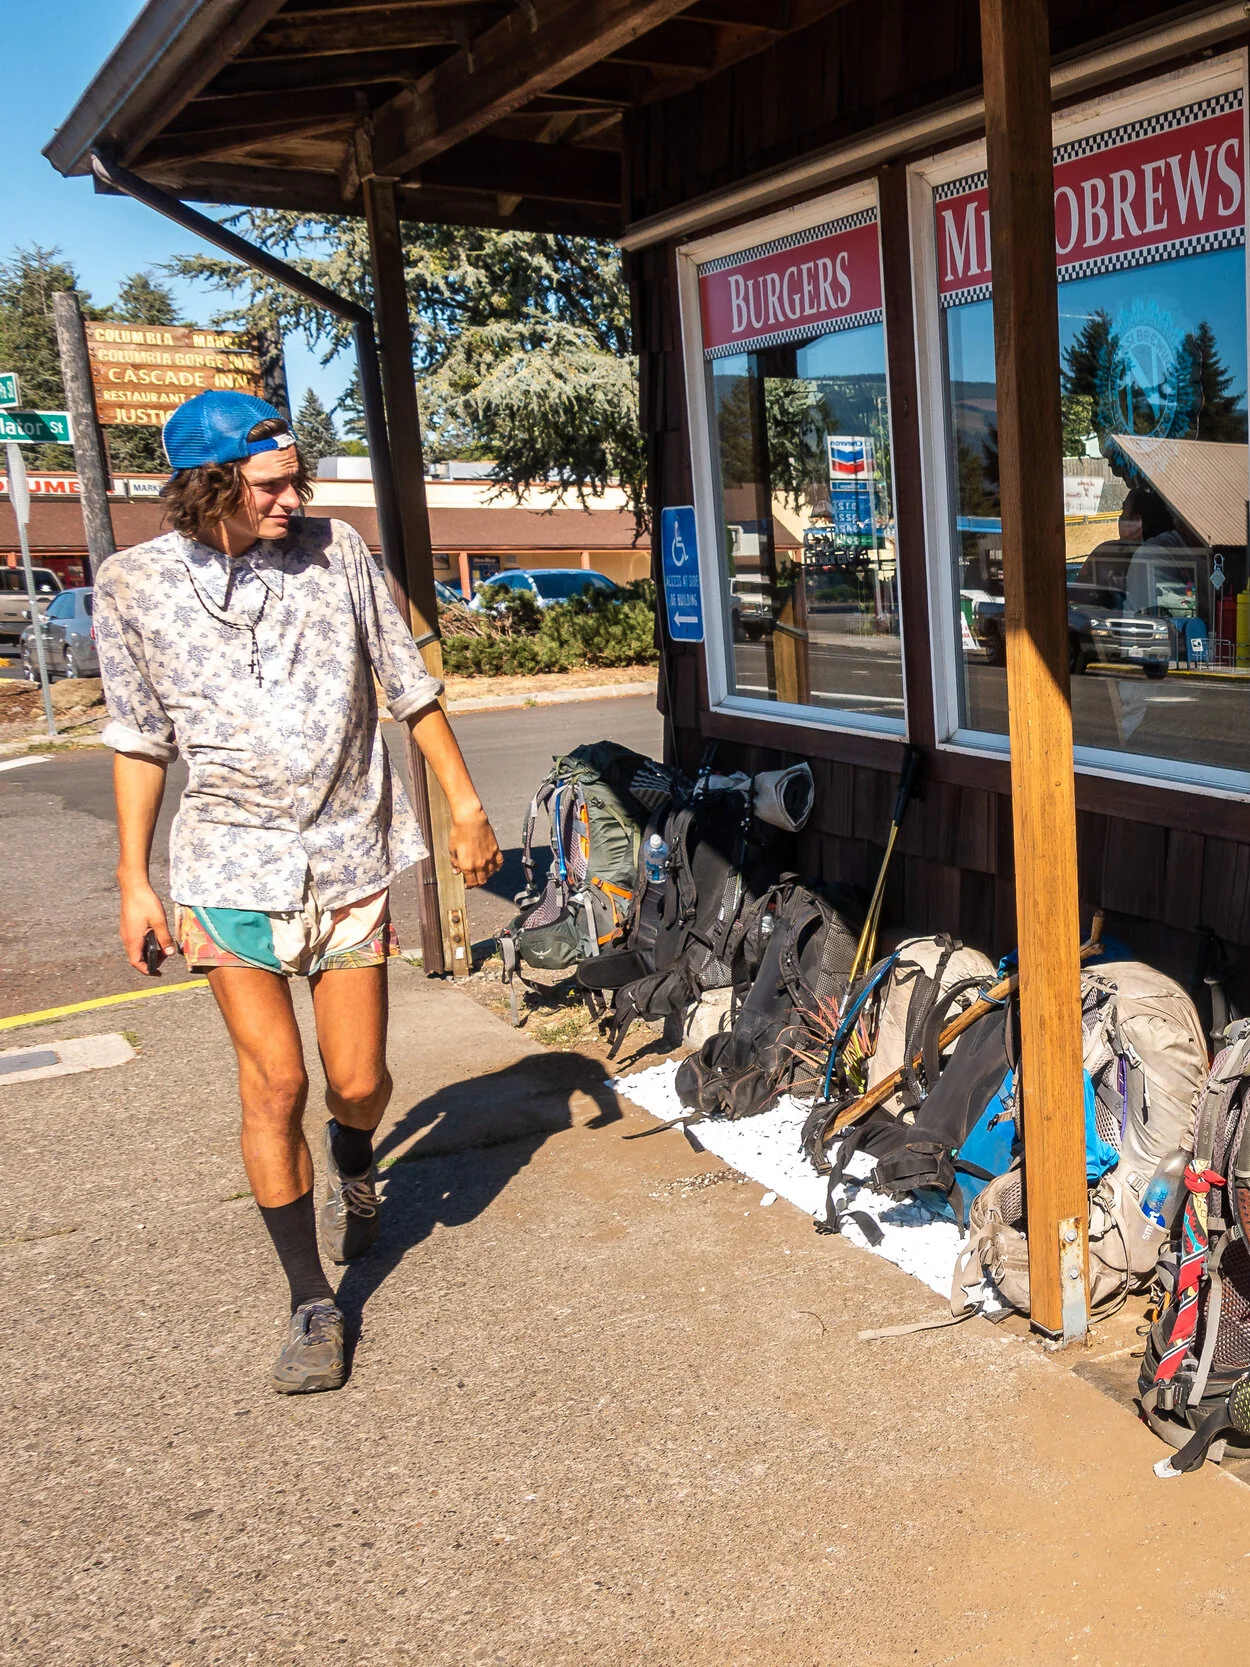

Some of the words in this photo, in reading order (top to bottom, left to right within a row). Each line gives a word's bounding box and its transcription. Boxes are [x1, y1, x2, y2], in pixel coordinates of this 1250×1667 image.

[941, 138, 1242, 282] MIOBREWS
[728, 251, 851, 333] BURGERS
[94, 328, 175, 345] COLUMBIA
[192, 334, 250, 349] MARK
[98, 348, 172, 365] COLUMBIA
[174, 352, 224, 368] GORGE
[108, 368, 206, 387] CASCADE
[214, 373, 249, 388] INN
[103, 390, 186, 403] RESTAURANT
[49, 421, 65, 434] St
[133, 484, 163, 492] MARK
[1142, 1191, 1168, 1241] smrtwater
